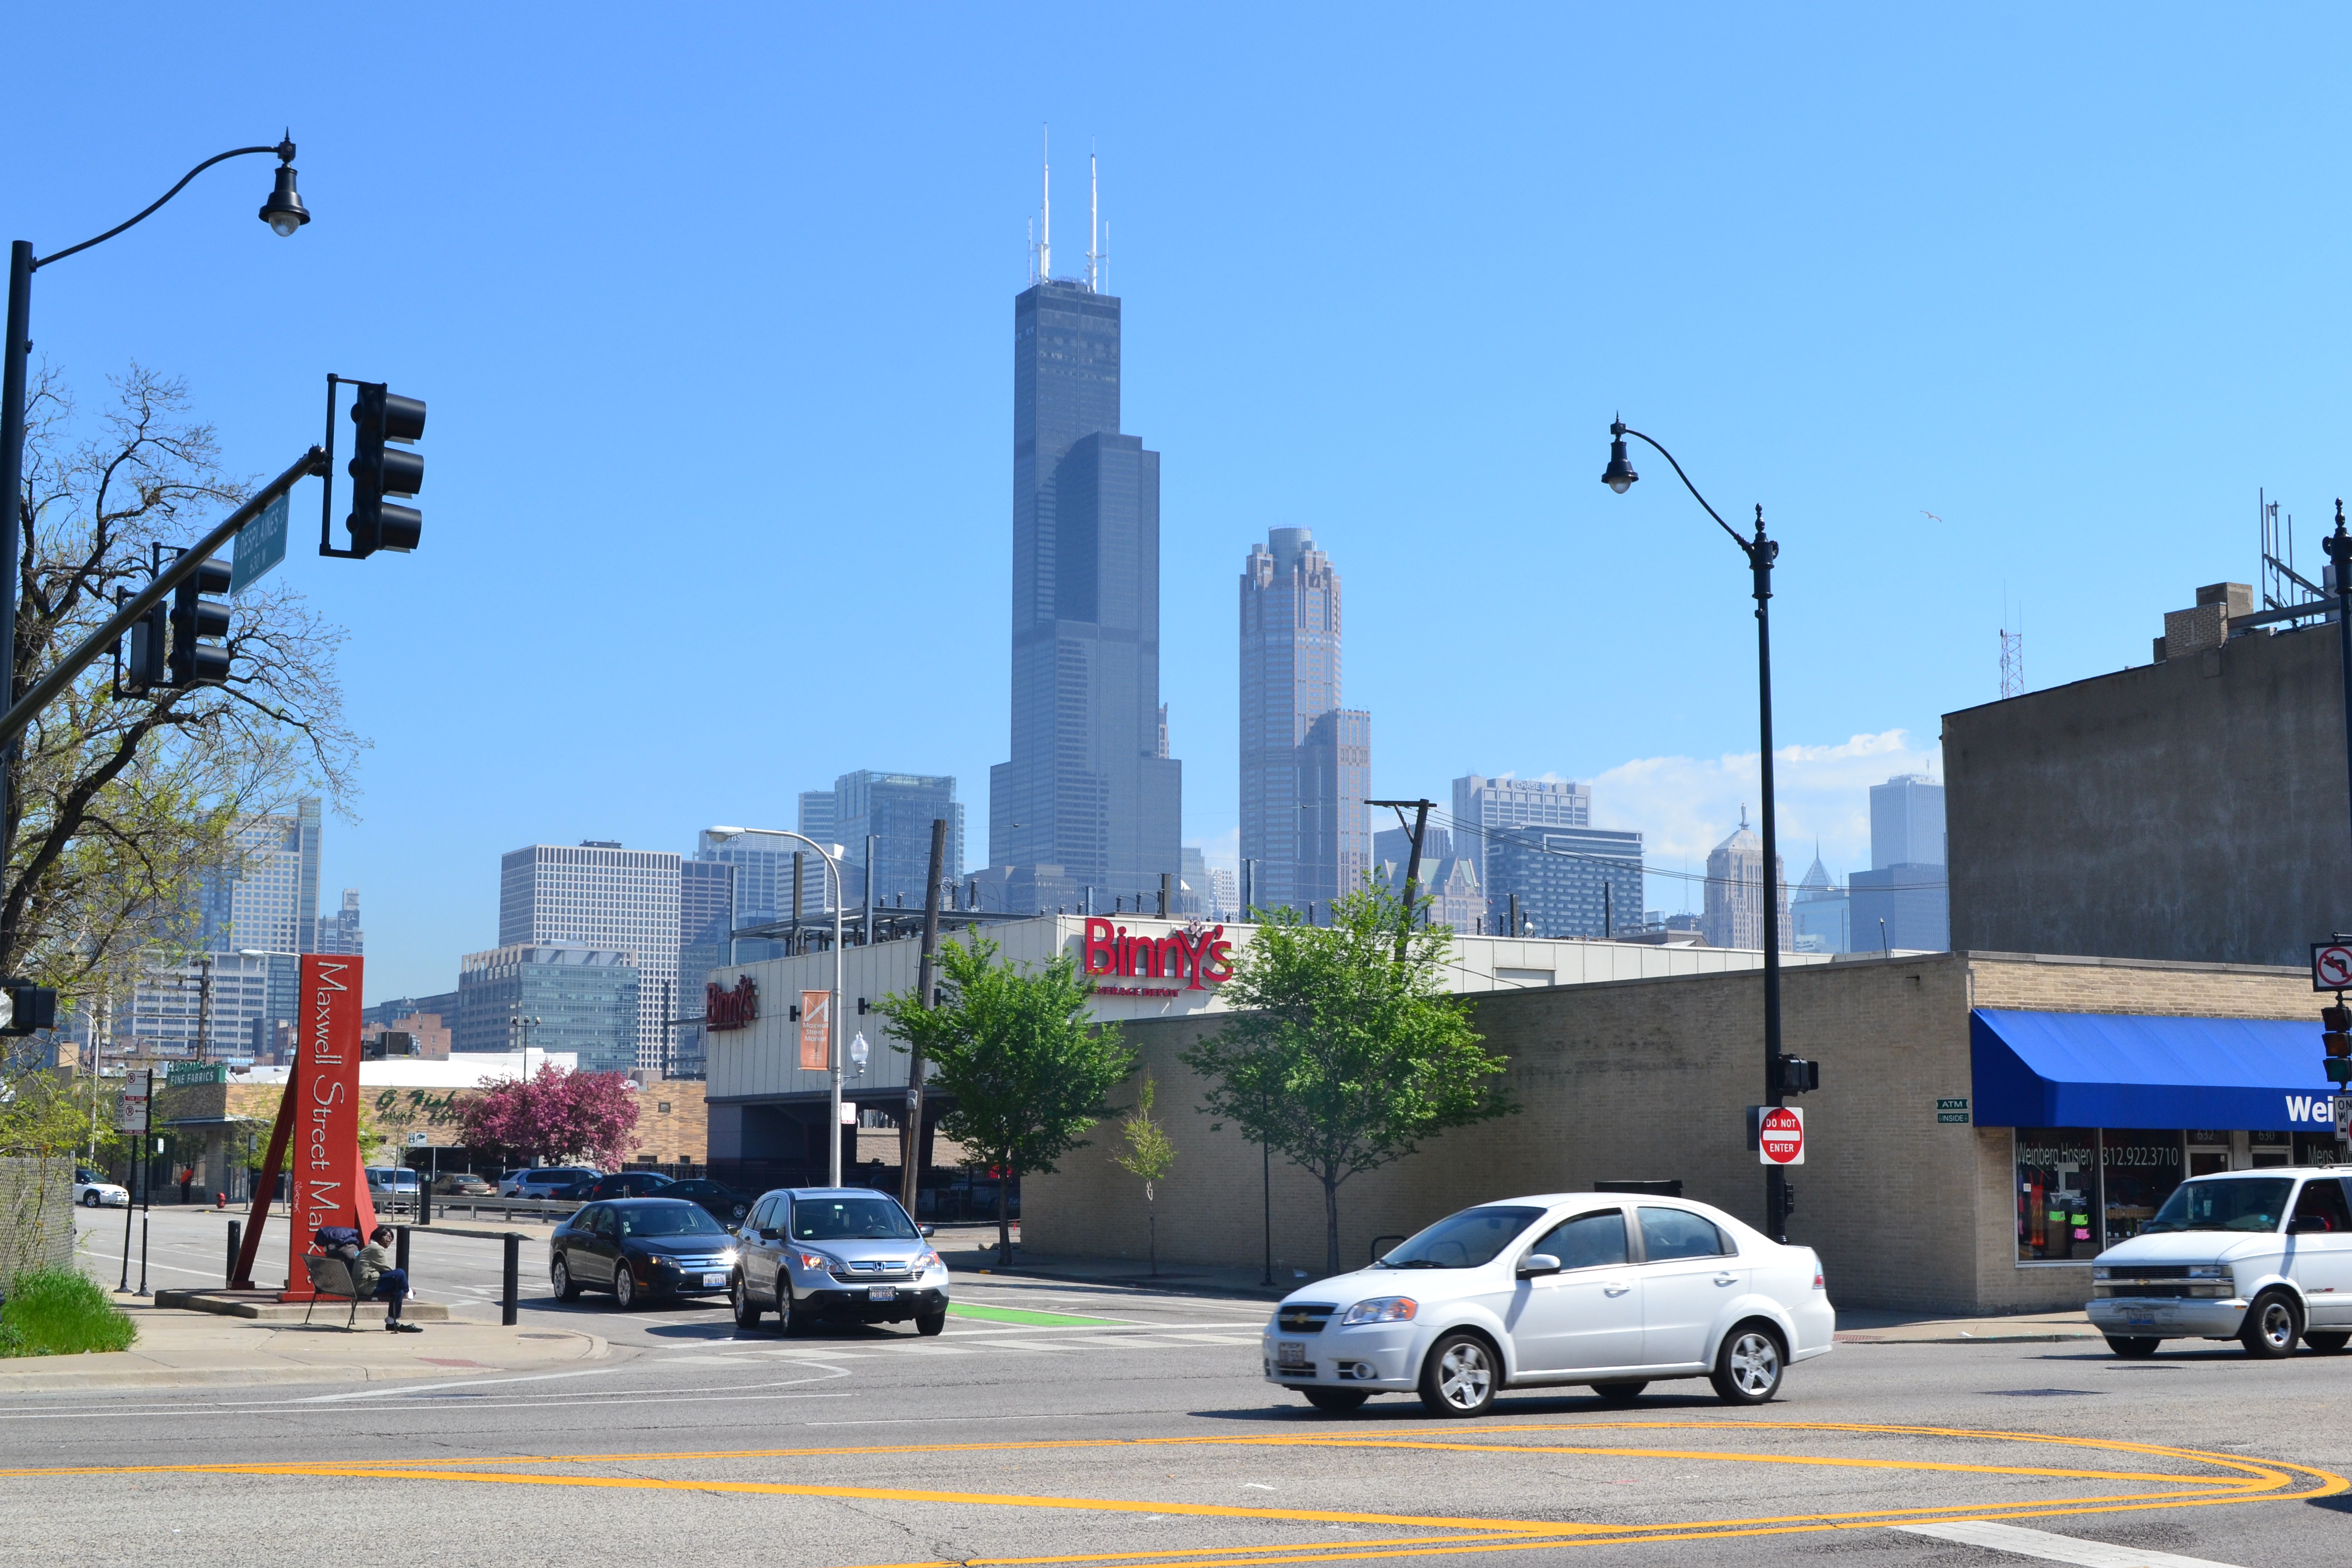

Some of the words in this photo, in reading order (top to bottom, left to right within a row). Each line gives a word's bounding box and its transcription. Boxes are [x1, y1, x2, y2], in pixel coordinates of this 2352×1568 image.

[234, 544, 238, 560] S
[239, 507, 279, 560] DESPLAINES
[249, 553, 260, 574] 630
[1516, 781, 1540, 790] CHASE
[1084, 917, 1234, 991] Binny's
[1142, 988, 1180, 998] DEPOT
[314, 961, 348, 1065] Maxwell
[170, 1074, 185, 1085] FINE
[187, 1071, 214, 1083] FABRICS
[2285, 1095, 2334, 1122] Wei
[310, 1074, 344, 1170] Street
[1766, 1118, 1777, 1128] DO
[1781, 1119, 1796, 1128] NOT
[2197, 1130, 2214, 1140] 632
[2259, 1131, 2275, 1141] 630
[1770, 1143, 1794, 1153] ENTER
[2016, 1142, 2059, 1171] Weinberg
[2061, 1143, 2093, 1171] Hosiery
[2103, 1147, 2178, 1166] 312.922.3710
